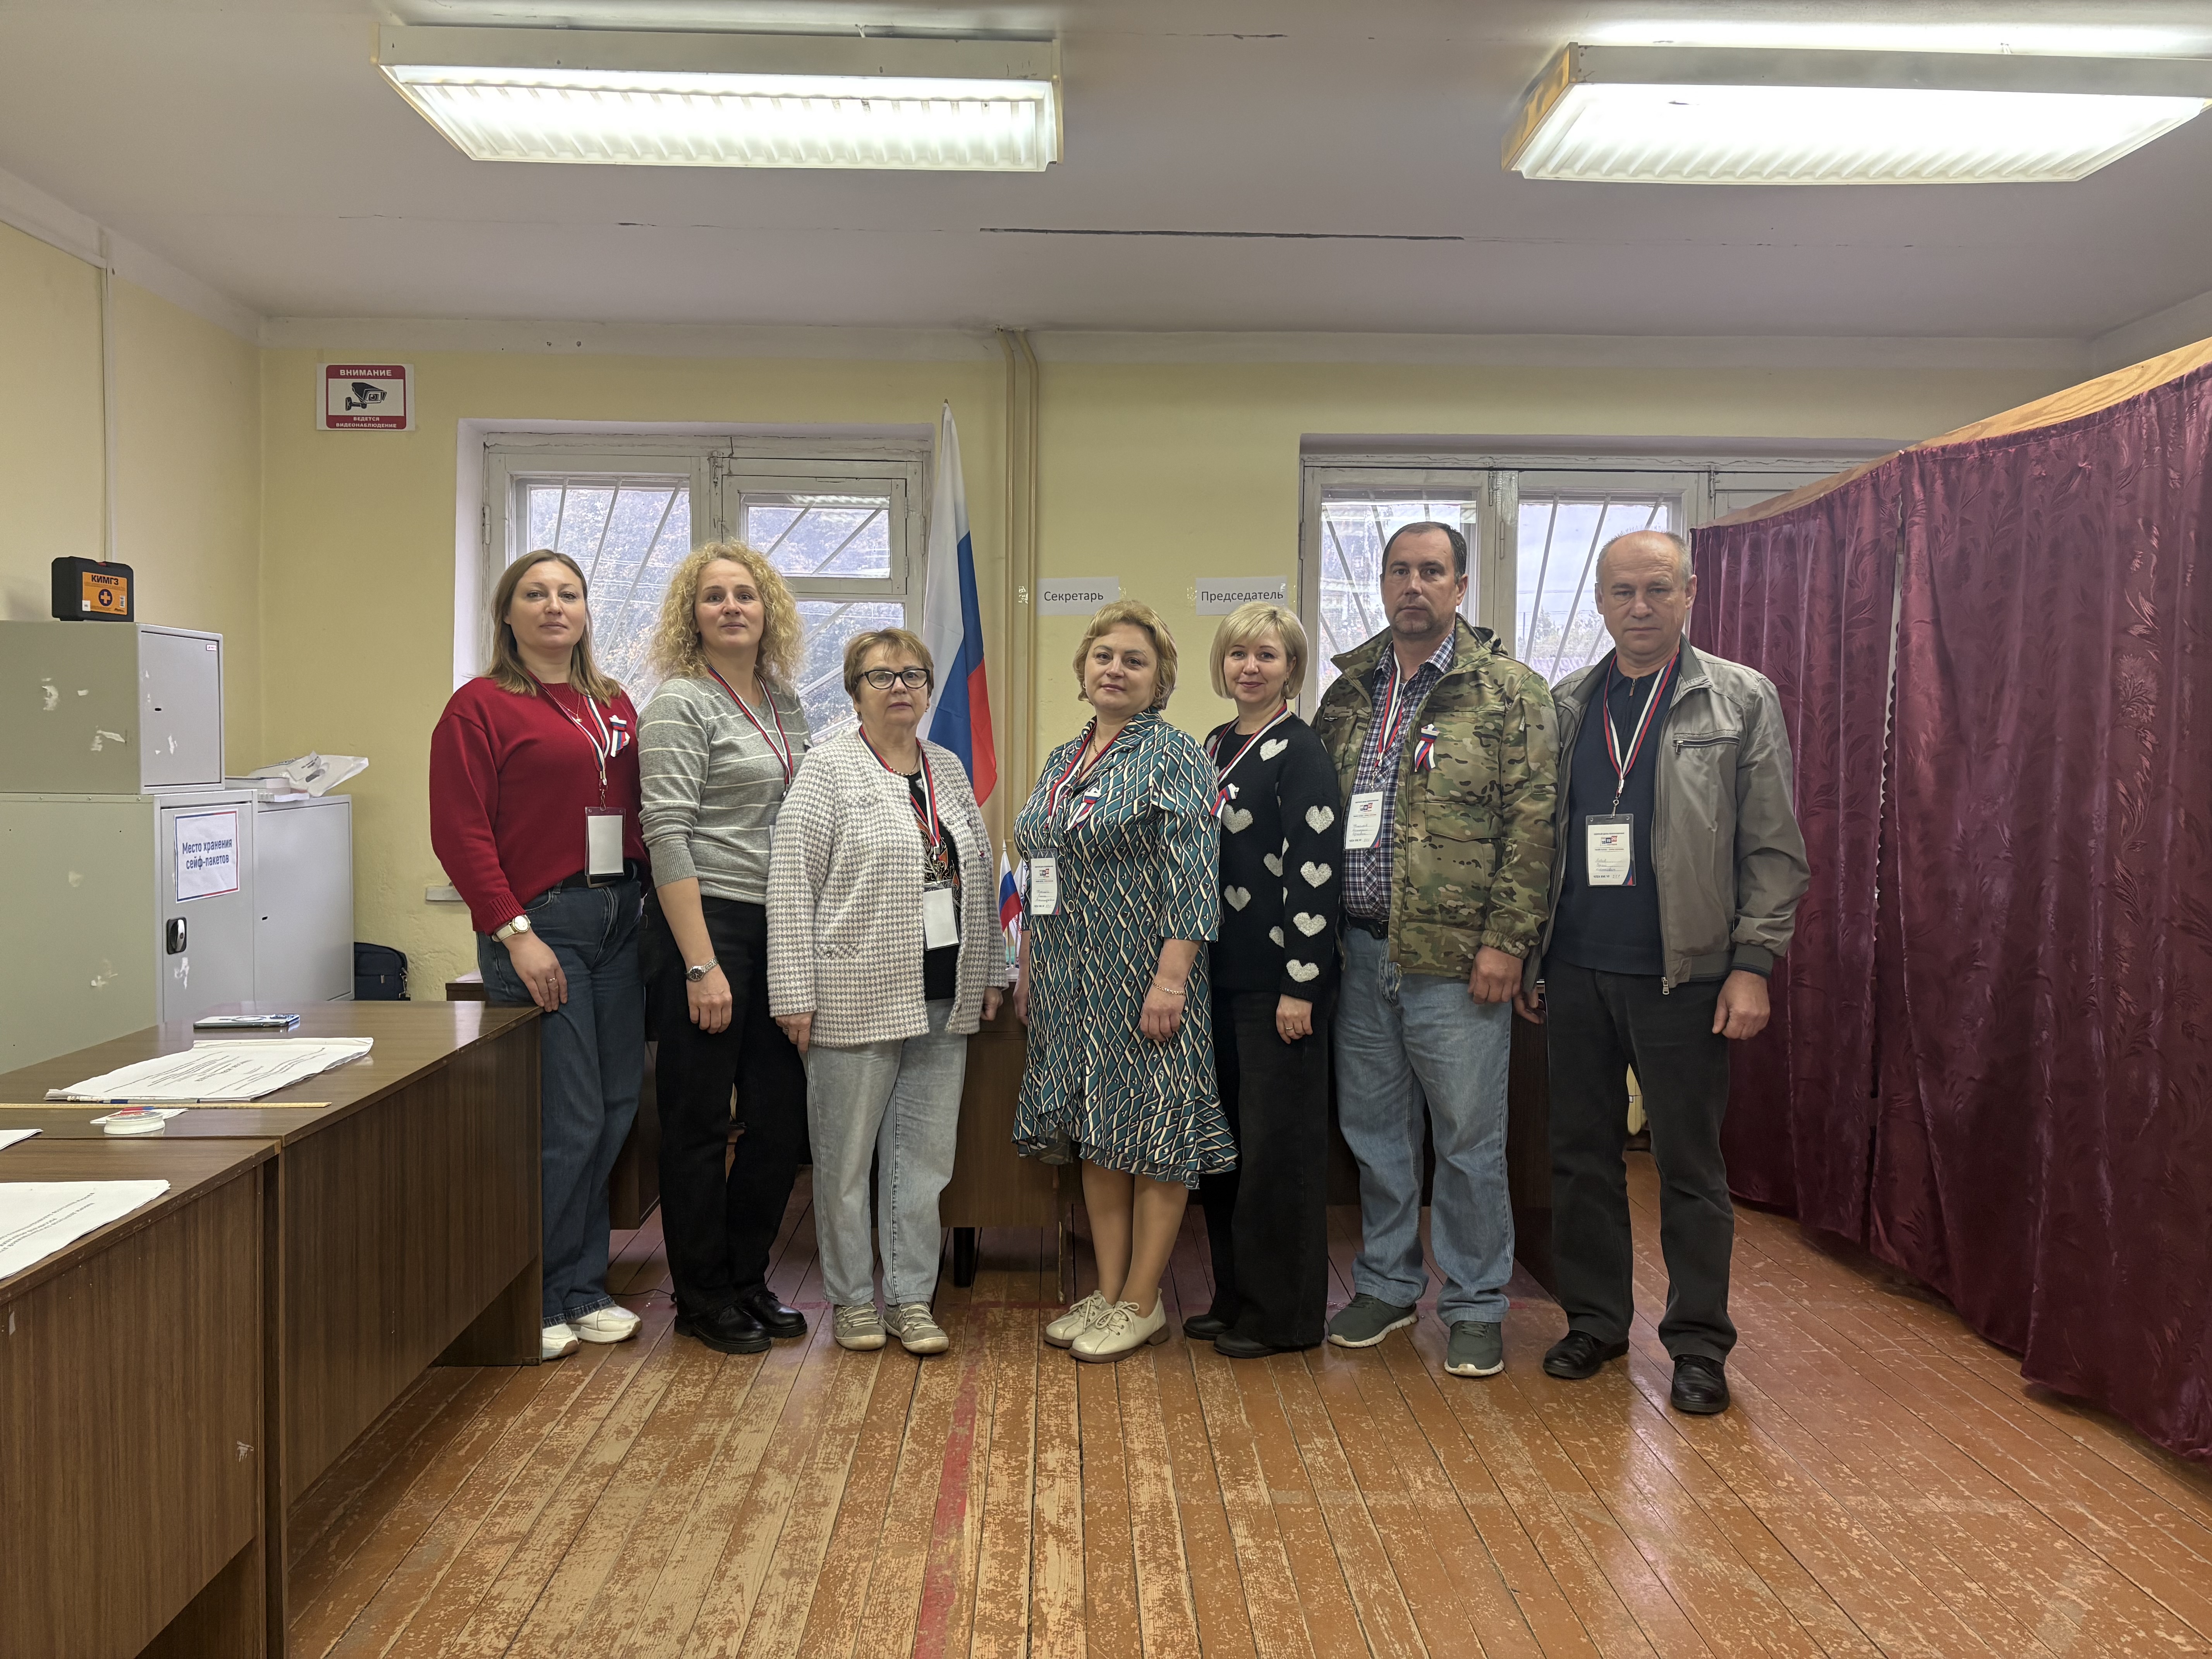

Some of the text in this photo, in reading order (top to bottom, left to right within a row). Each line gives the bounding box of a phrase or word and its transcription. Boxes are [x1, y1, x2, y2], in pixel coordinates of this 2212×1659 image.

[91, 575, 119, 585] КИМГЗ
[1044, 591, 1103, 603] Секретарь
[1202, 591, 1283, 603] Председатель
[182, 839, 232, 854] Место хранения
[186, 854, 229, 870] сейф-пакетов
